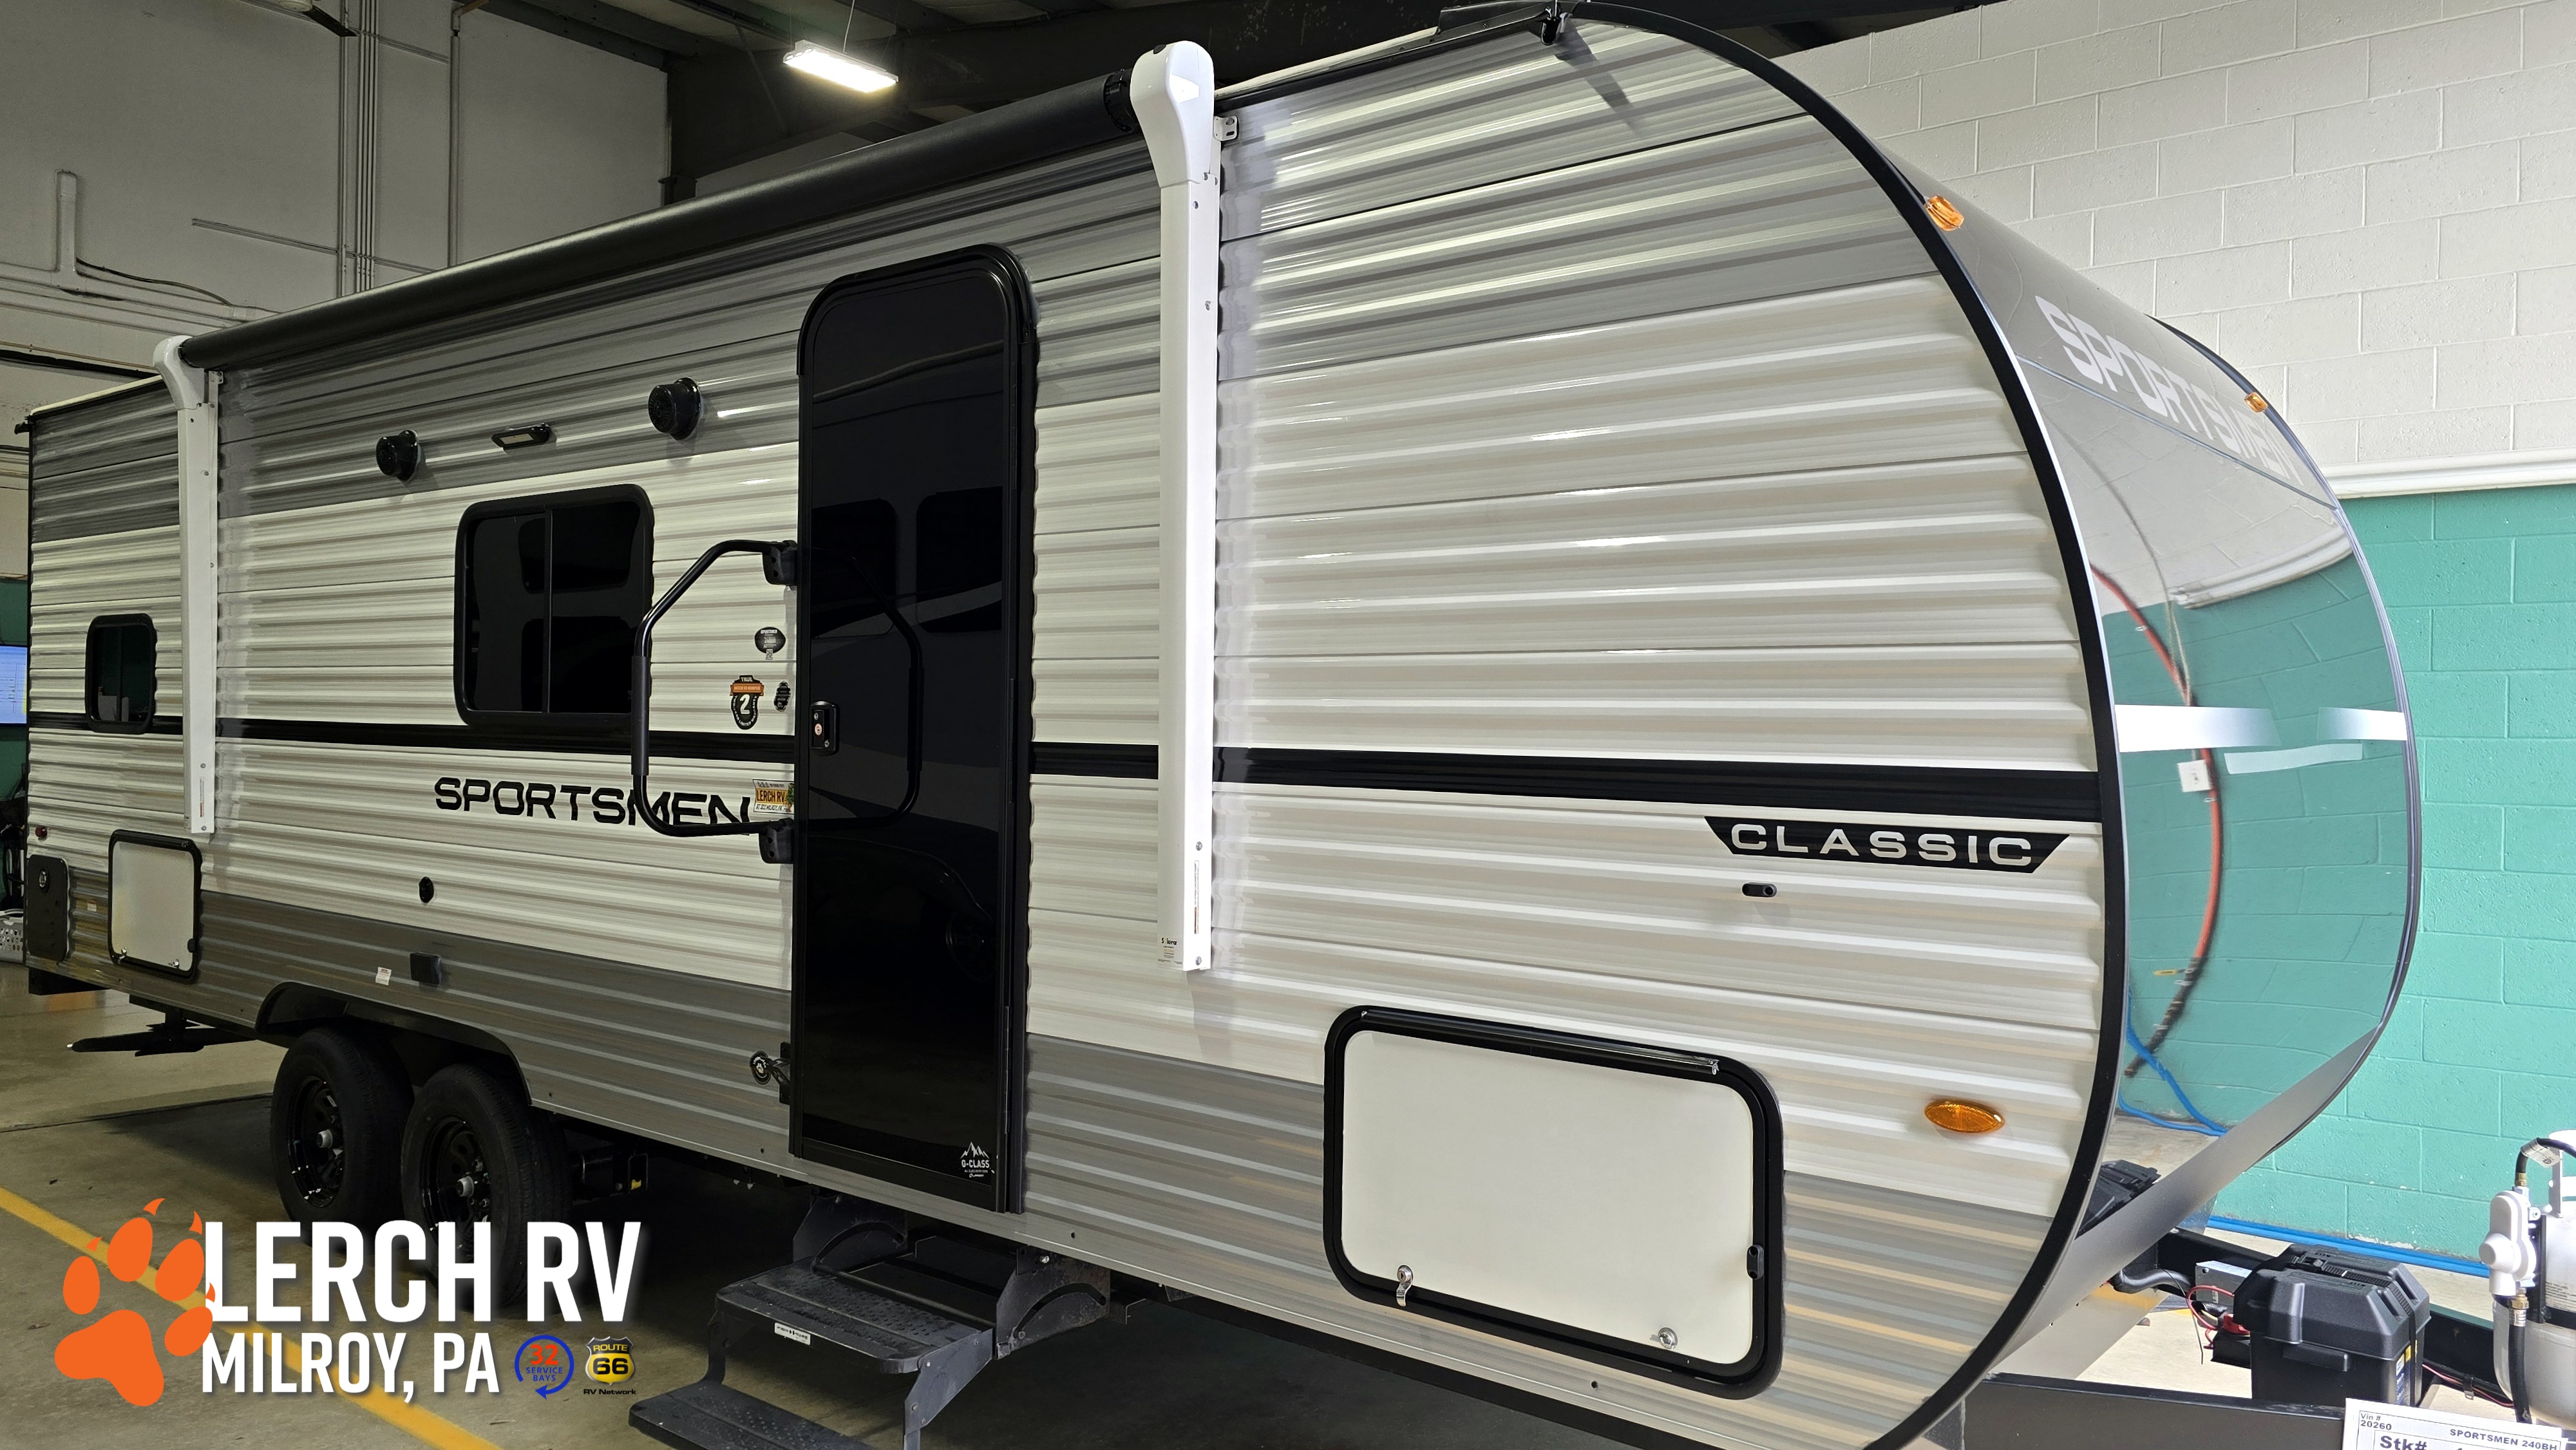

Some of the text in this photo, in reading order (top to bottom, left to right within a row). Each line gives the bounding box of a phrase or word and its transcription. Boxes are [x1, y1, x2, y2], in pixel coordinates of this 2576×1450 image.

[2035, 296, 2304, 487] SPORTSMEN
[740, 694, 750, 714] 2
[757, 789, 785, 803] LERCH RV
[1731, 824, 2031, 866] CLASSIC
[961, 1159, 990, 1168] G-CLASS
[2360, 1420, 2392, 1430] 20260
[2450, 1429, 2557, 1450] SPORTSMEN 240BH
